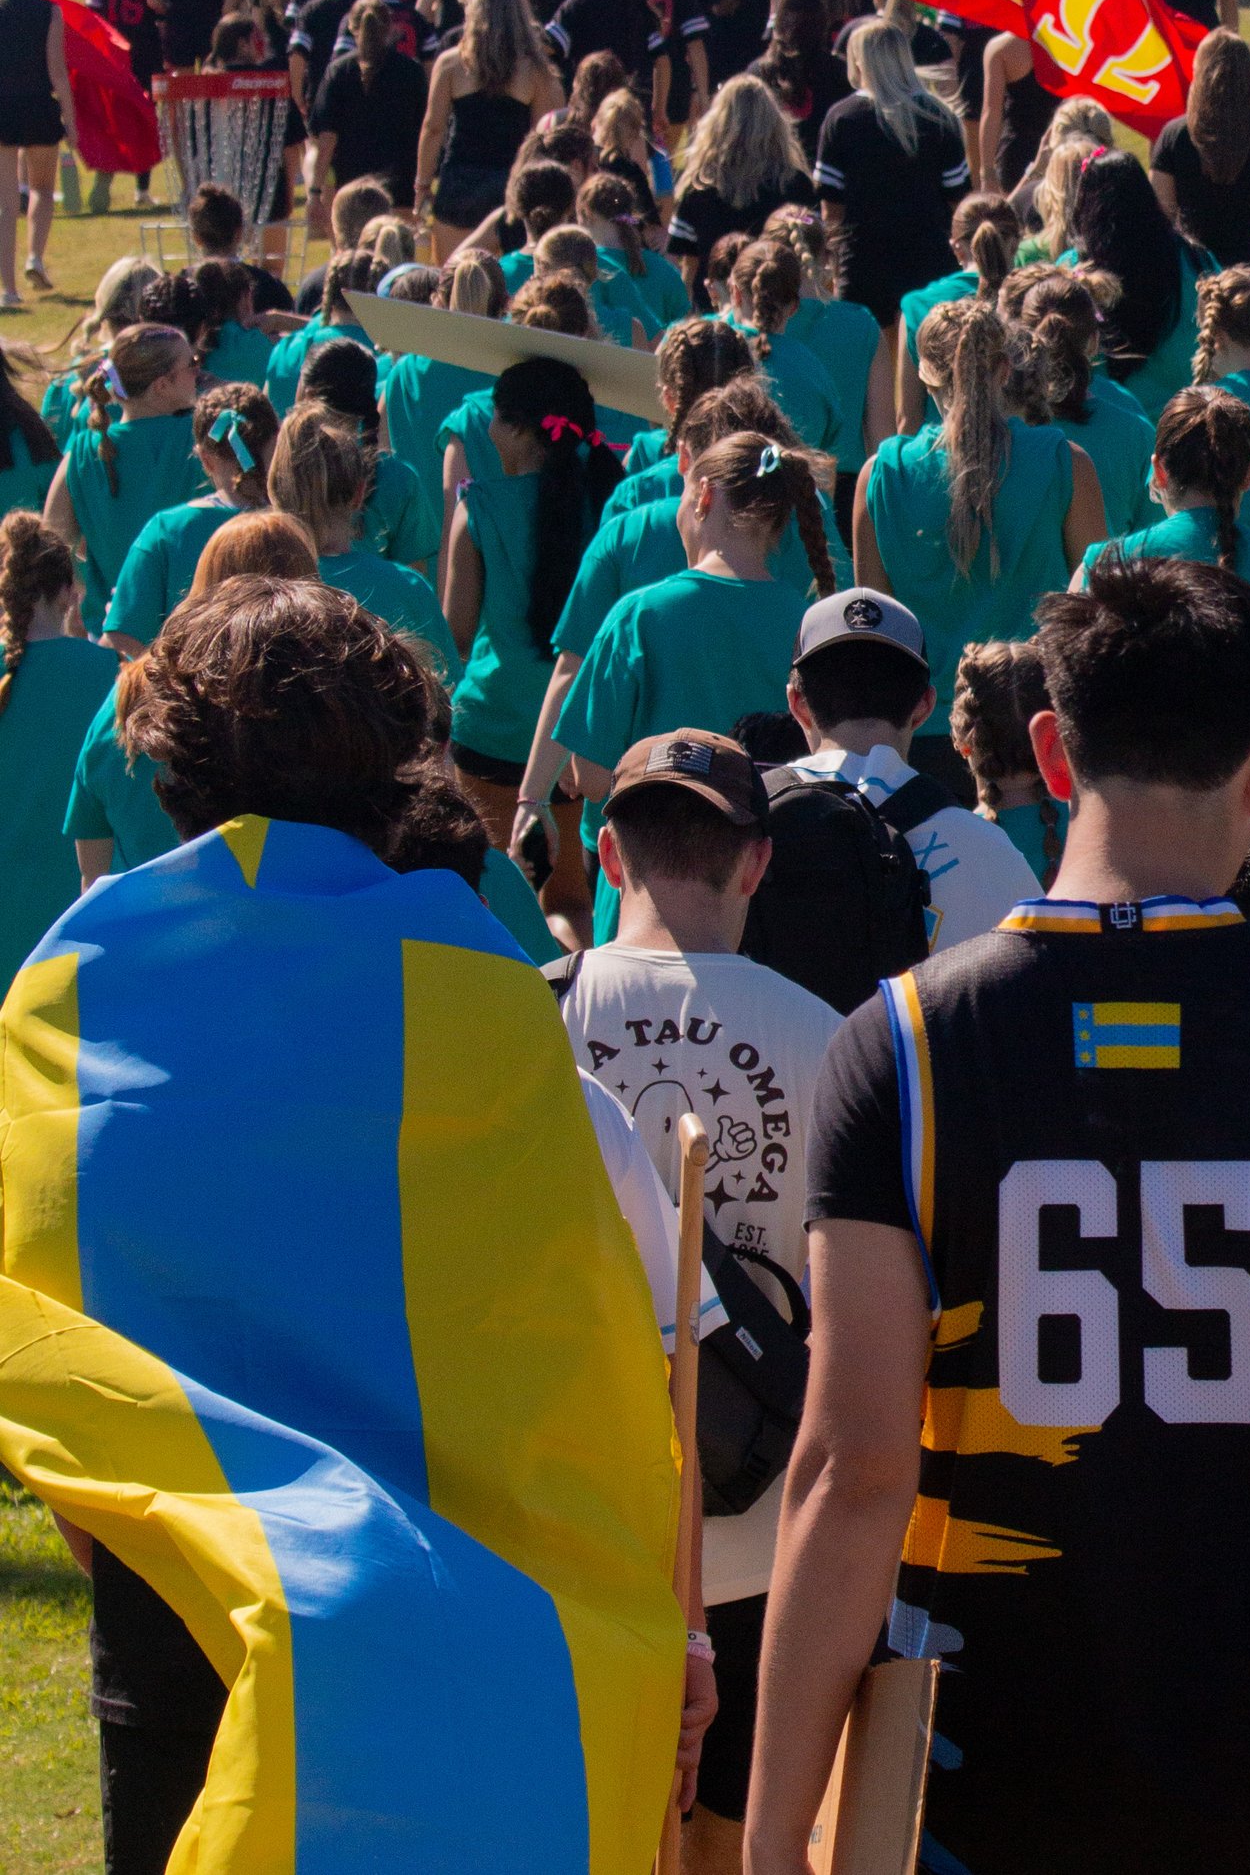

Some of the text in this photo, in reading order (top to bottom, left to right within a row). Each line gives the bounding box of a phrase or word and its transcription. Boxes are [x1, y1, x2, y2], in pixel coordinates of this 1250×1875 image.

[625, 1017, 722, 1047] TAU
[728, 1042, 791, 1203] OMEGA
[734, 1221, 767, 1246] EST.
